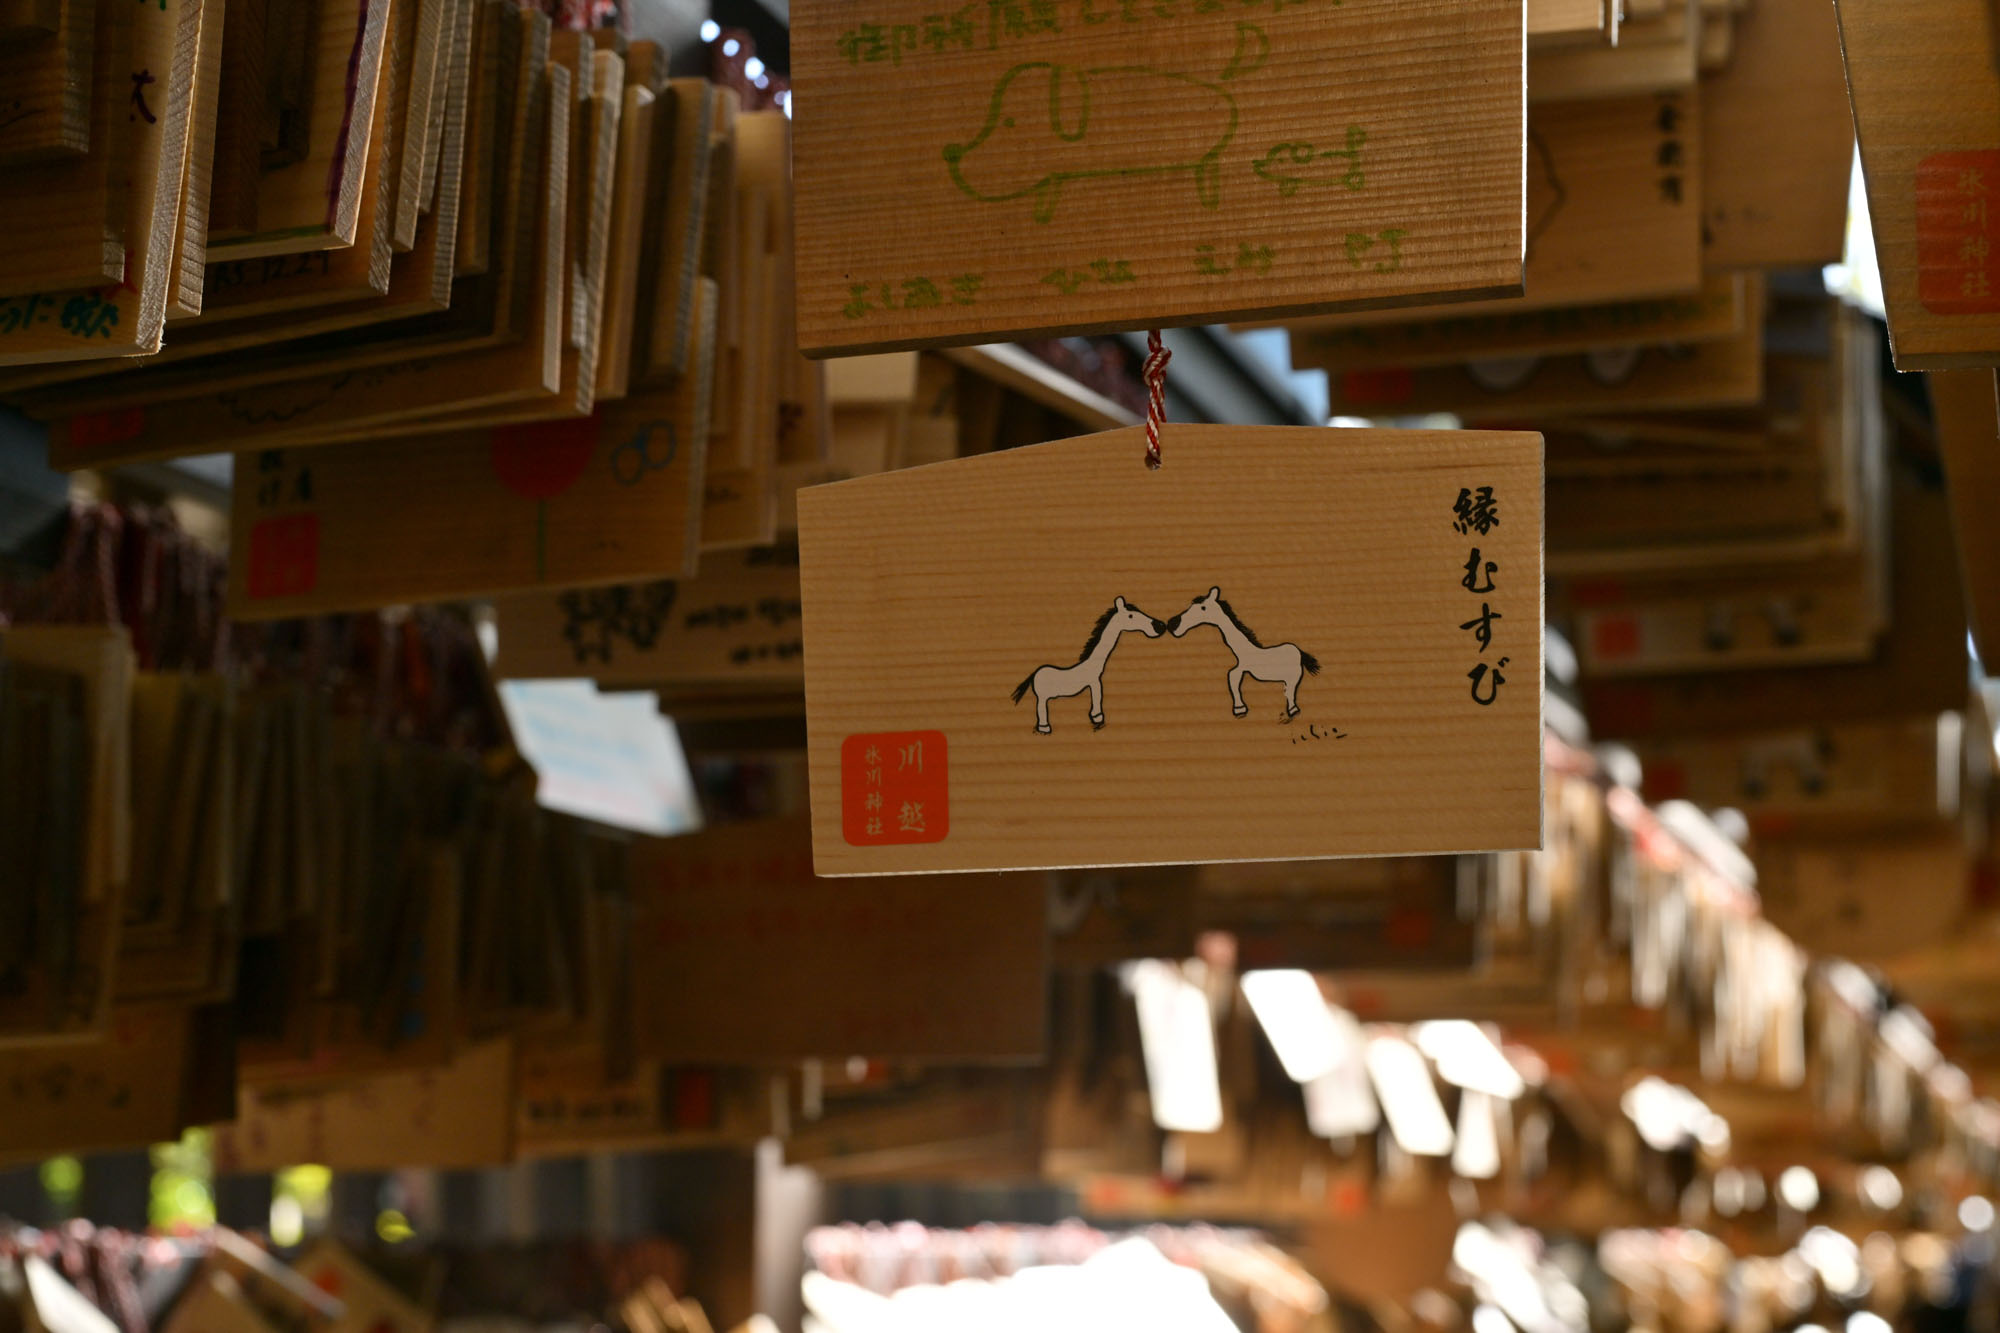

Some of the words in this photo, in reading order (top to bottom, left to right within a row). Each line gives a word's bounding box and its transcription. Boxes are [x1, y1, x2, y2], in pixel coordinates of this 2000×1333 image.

[1957, 167, 1991, 297] 氷川神社
[1453, 486, 1510, 706] 縁むすび
[864, 744, 884, 836] 氷川神社
[897, 739, 927, 833] 川越
